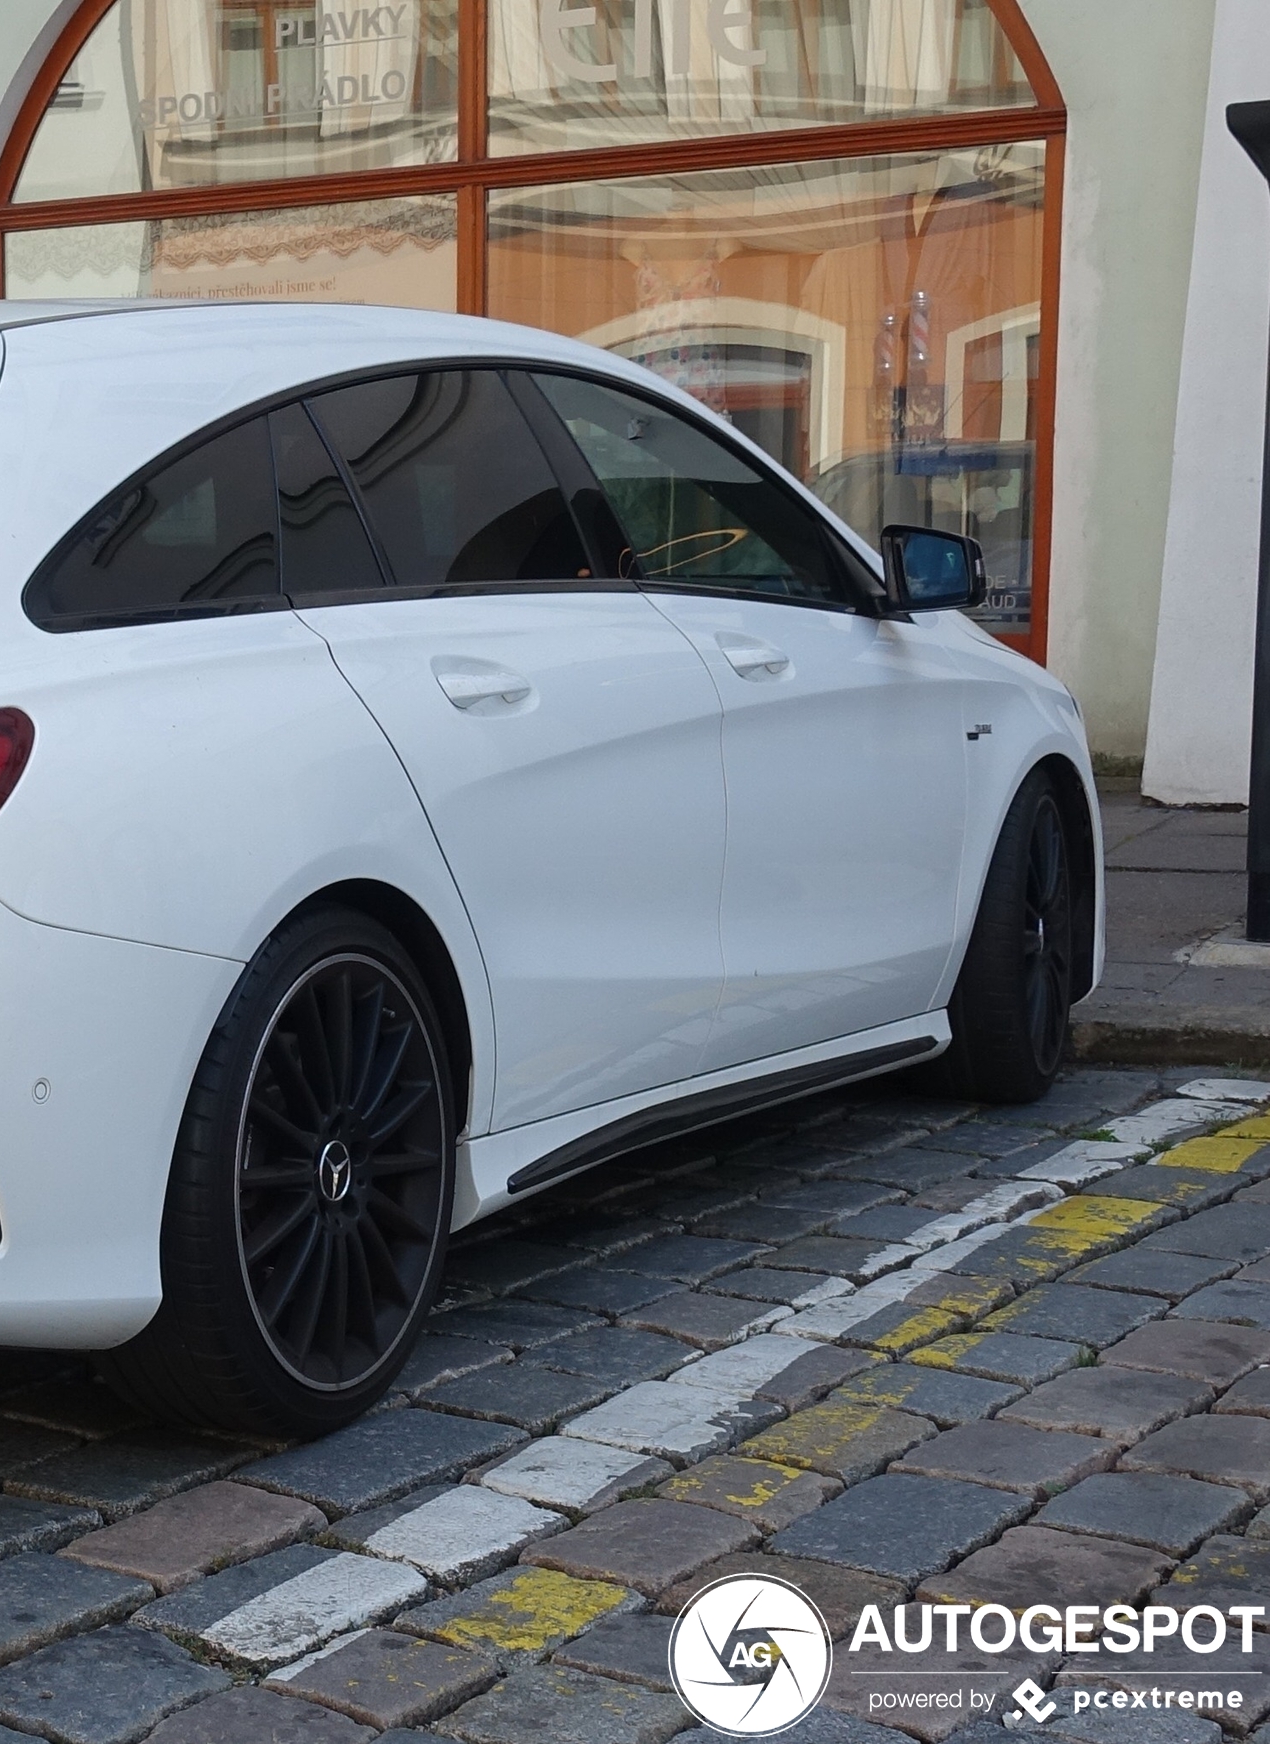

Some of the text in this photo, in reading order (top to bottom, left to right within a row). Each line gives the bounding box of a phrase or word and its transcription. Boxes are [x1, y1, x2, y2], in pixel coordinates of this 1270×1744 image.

[274, 4, 407, 47] PLAVKY
[267, 70, 407, 114] PRÁDLO
[285, 282, 316, 296] jsme
[319, 276, 337, 292] se!
